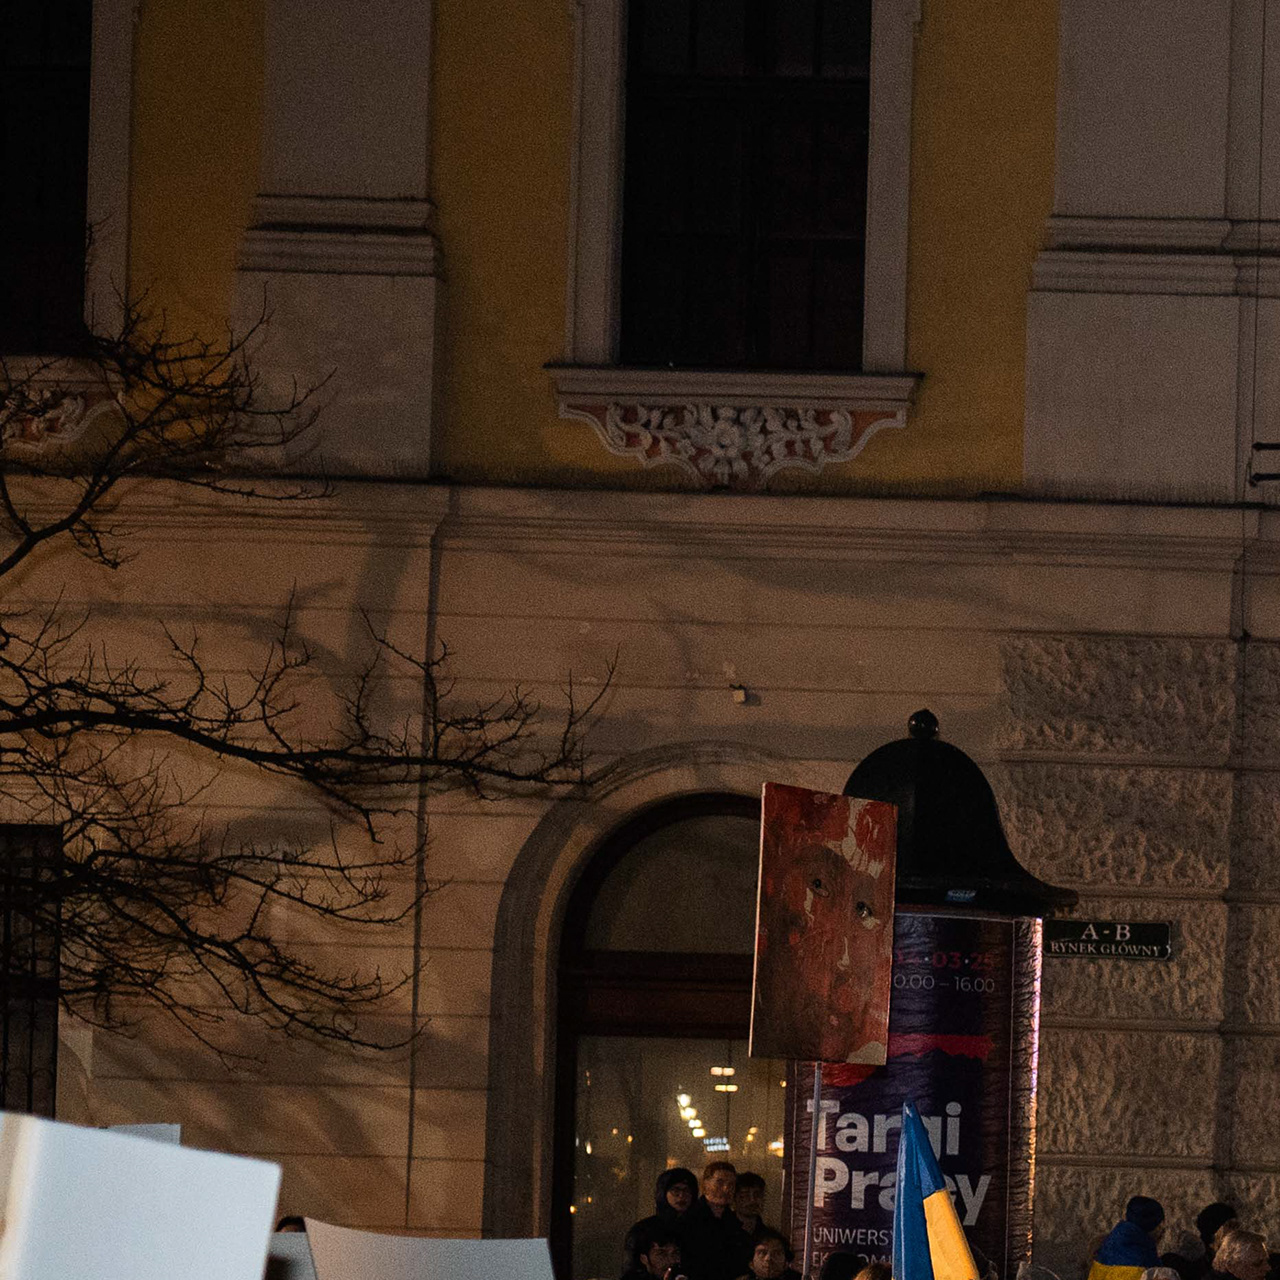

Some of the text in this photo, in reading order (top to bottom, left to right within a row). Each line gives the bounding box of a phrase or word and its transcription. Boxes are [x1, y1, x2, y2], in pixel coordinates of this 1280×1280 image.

[1050, 941, 1161, 957] RYNEK GŁÓWNY
[894, 974, 935, 989] 0.00
[954, 976, 996, 993] 16.00
[813, 1227, 894, 1246] UNIWERS
